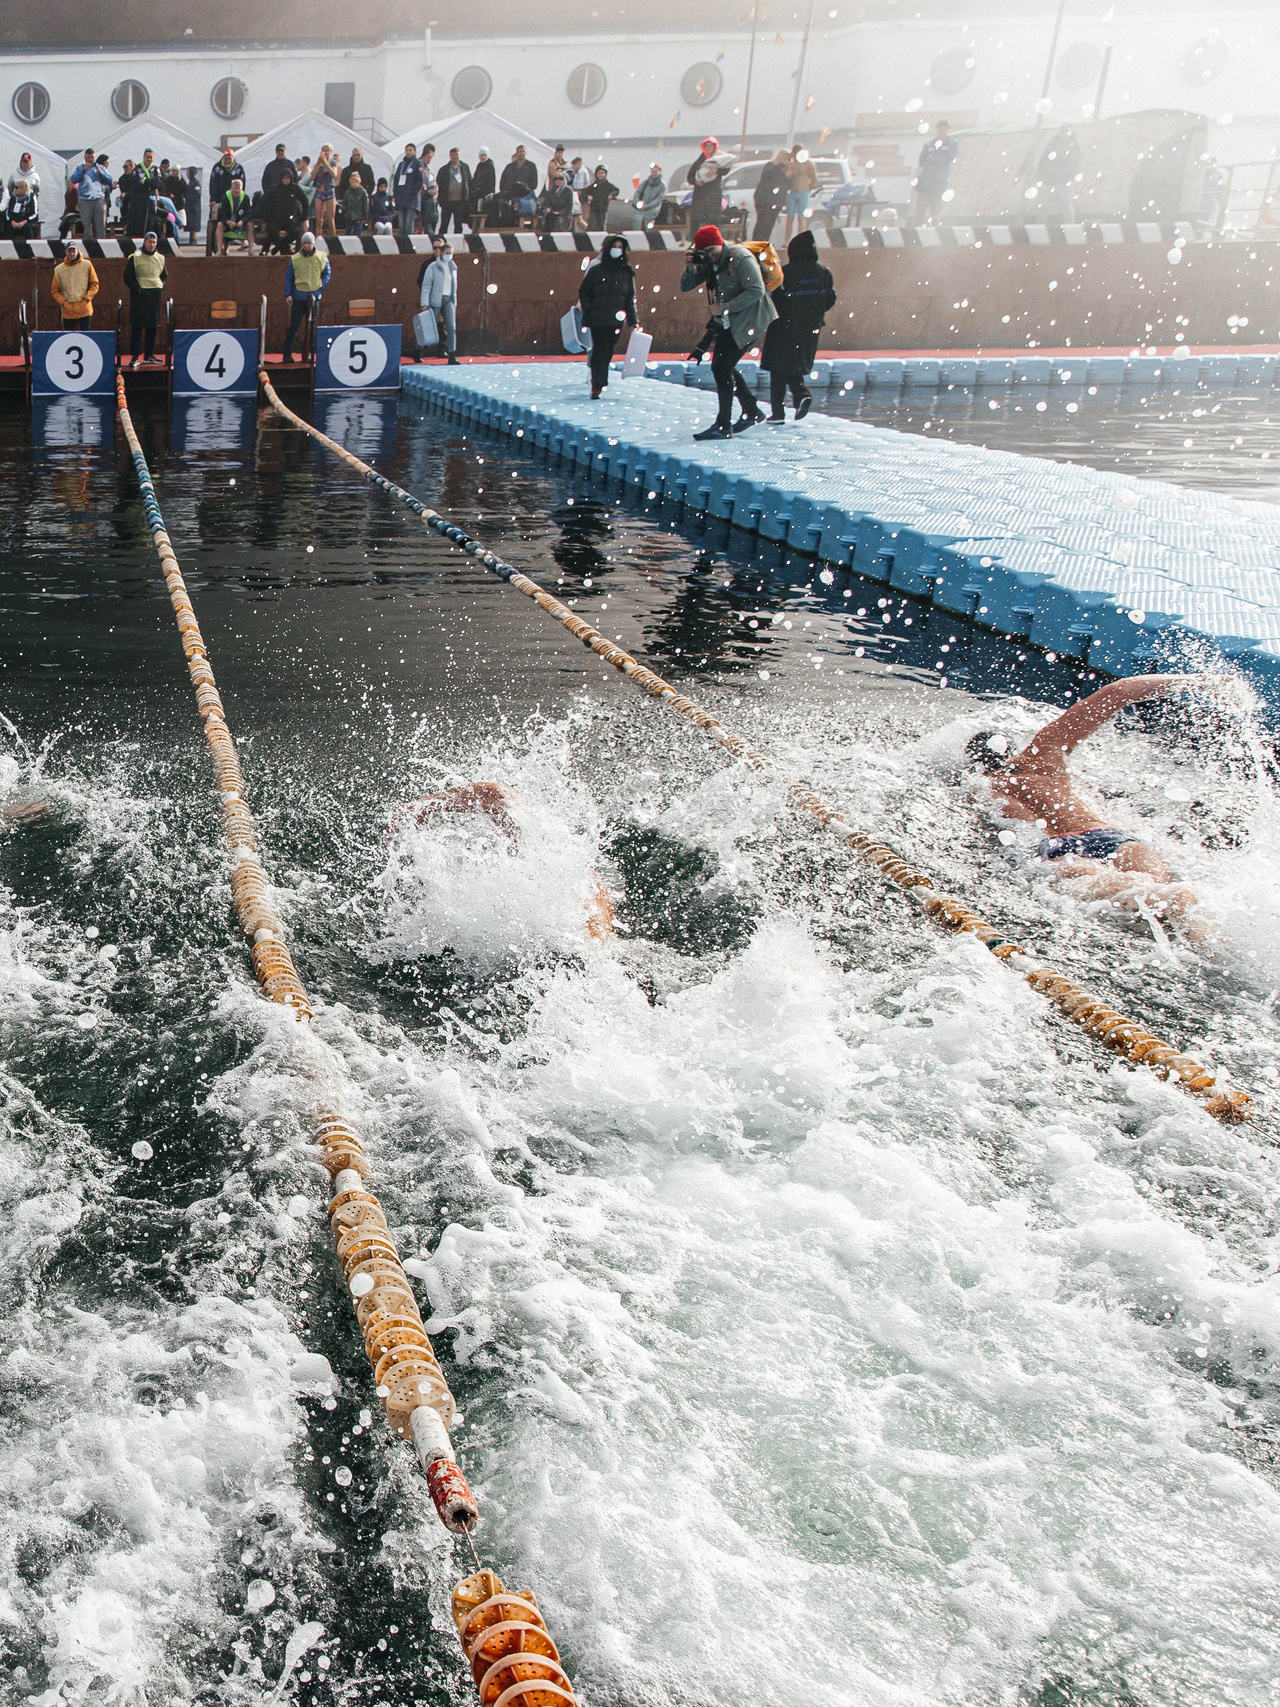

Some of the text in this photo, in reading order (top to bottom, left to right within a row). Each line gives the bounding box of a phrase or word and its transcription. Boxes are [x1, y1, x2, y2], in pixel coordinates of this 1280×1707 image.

[64, 345, 85, 380] 3
[204, 343, 226, 379] 4
[348, 339, 368, 375] 5
